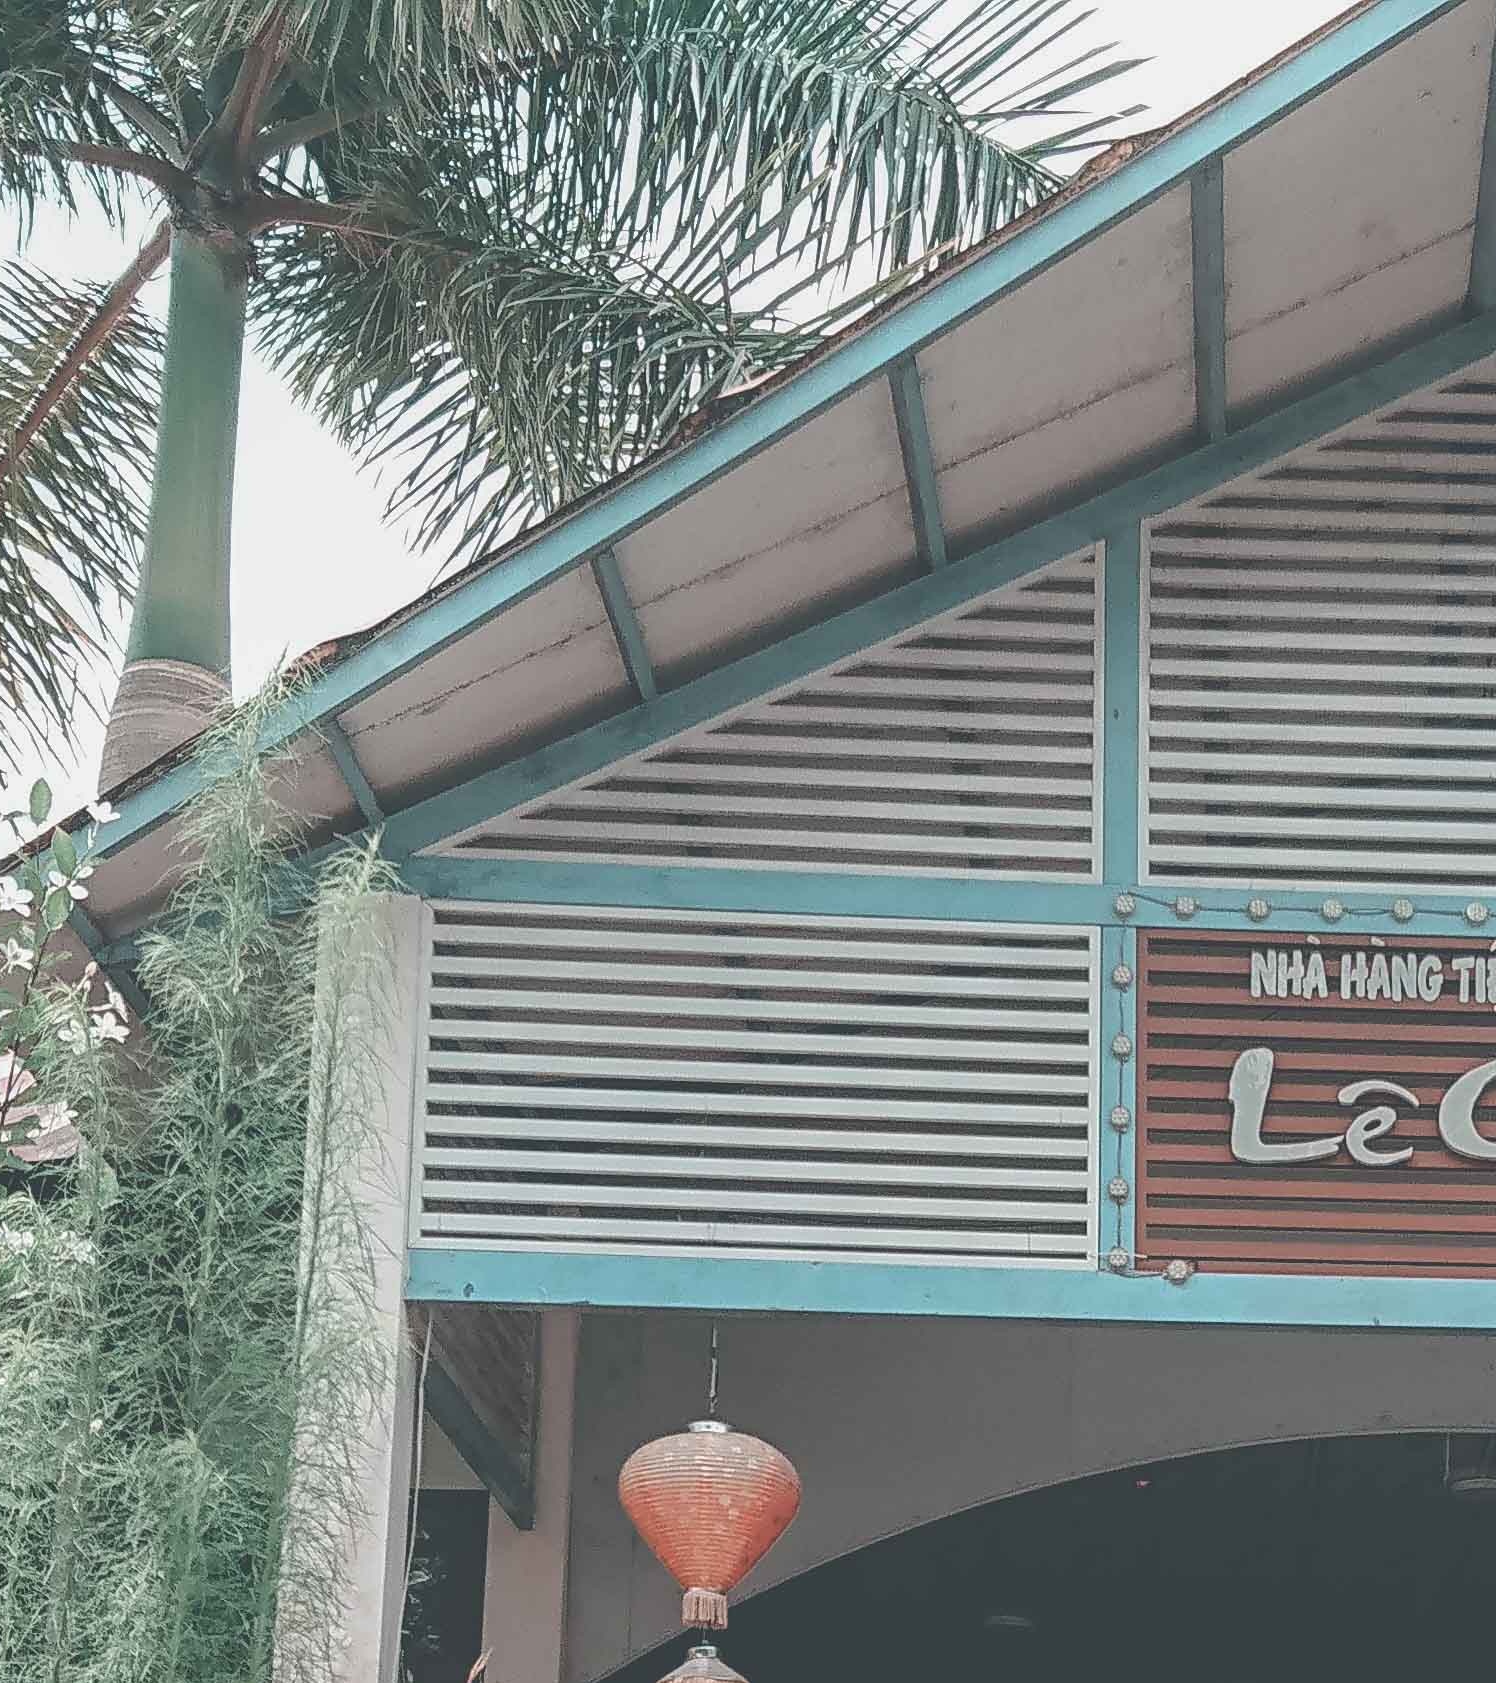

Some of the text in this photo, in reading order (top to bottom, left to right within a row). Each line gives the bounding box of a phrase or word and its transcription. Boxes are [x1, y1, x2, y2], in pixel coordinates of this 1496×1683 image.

[1250, 935, 1329, 1000] NHÀ
[1340, 936, 1444, 1002] HÀNG
[1228, 1047, 1420, 1166] Lê
